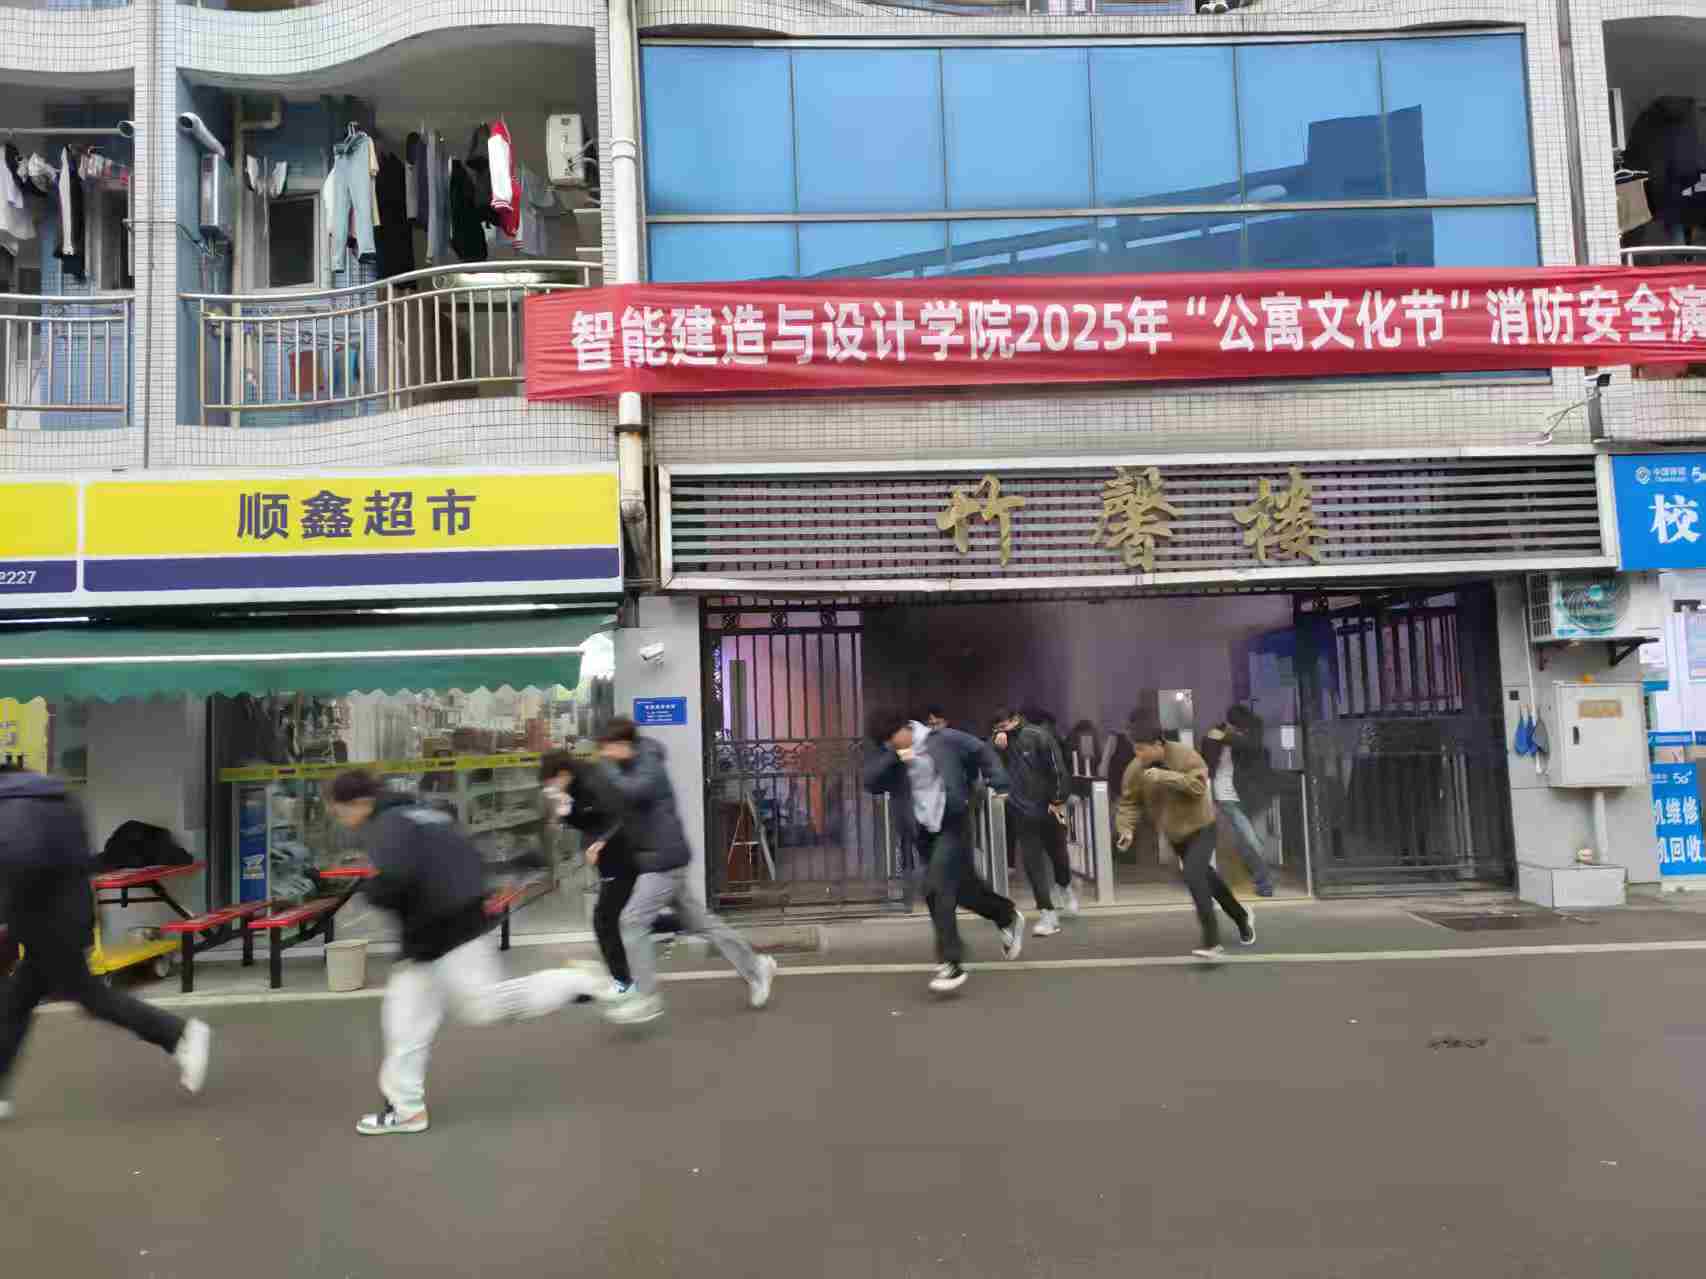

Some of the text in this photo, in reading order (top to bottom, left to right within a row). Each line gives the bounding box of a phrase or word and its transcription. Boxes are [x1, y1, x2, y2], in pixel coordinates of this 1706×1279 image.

[237, 489, 476, 540] 顺鑫超市
[1648, 494, 1701, 544] 校
